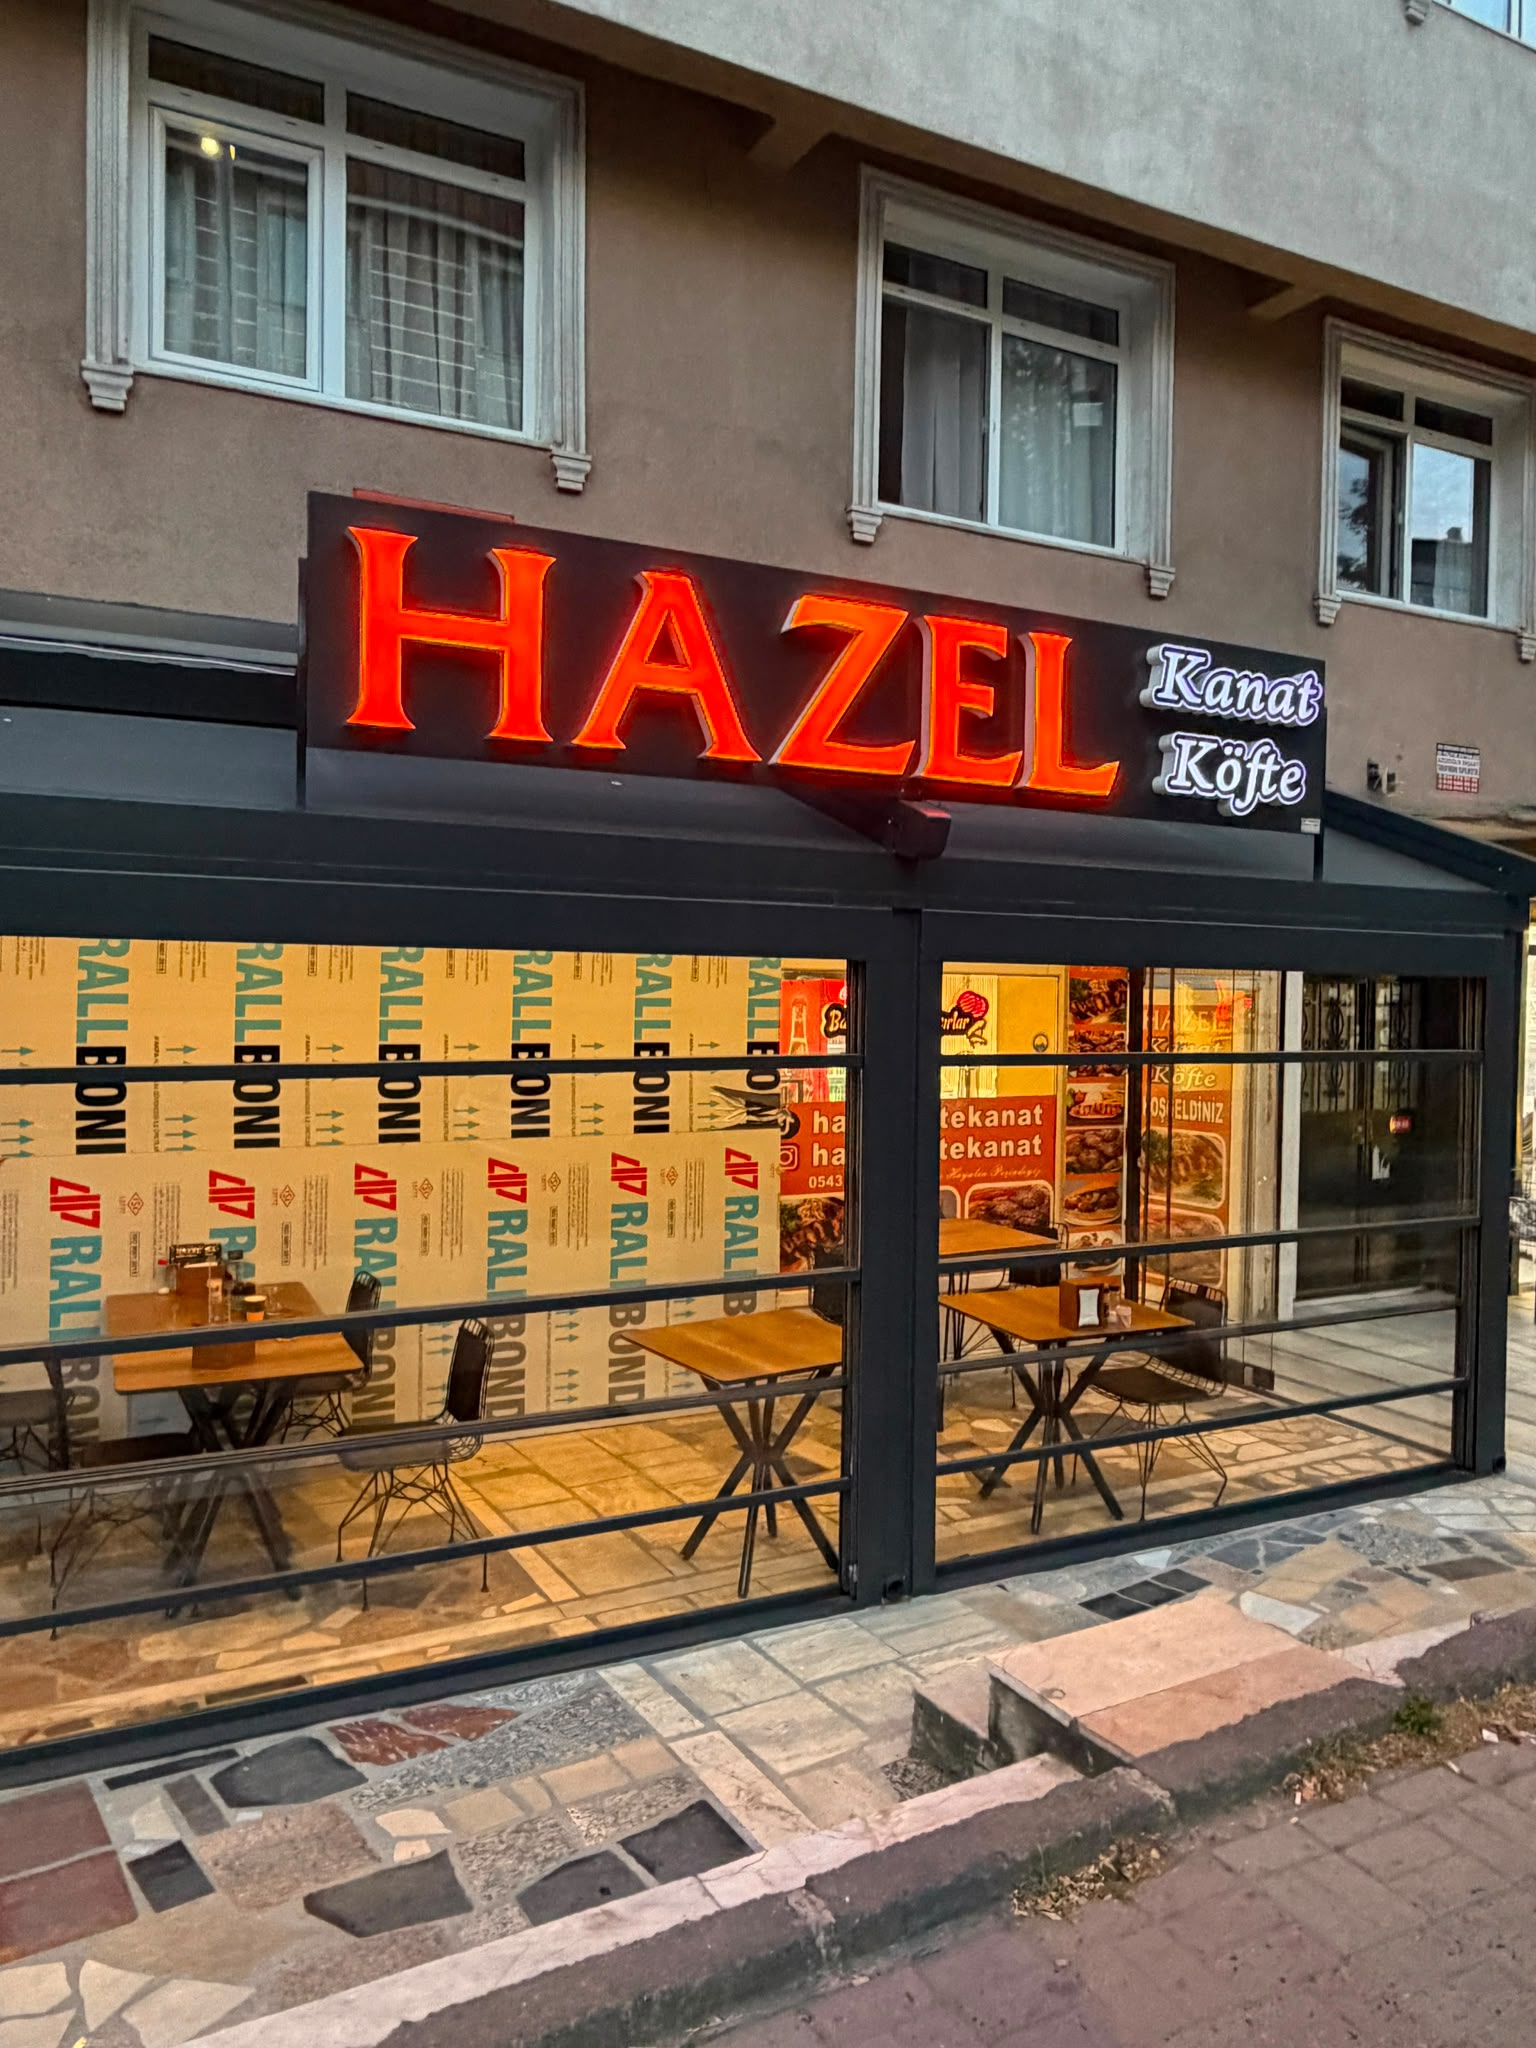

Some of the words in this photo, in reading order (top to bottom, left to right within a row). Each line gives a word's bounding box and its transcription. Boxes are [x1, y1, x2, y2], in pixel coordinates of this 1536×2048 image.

[346, 525, 1120, 797] HAZEL
[1154, 647, 1320, 723] Kanat
[1167, 735, 1304, 812] Köfte
[808, 1174, 844, 1190] 0543
